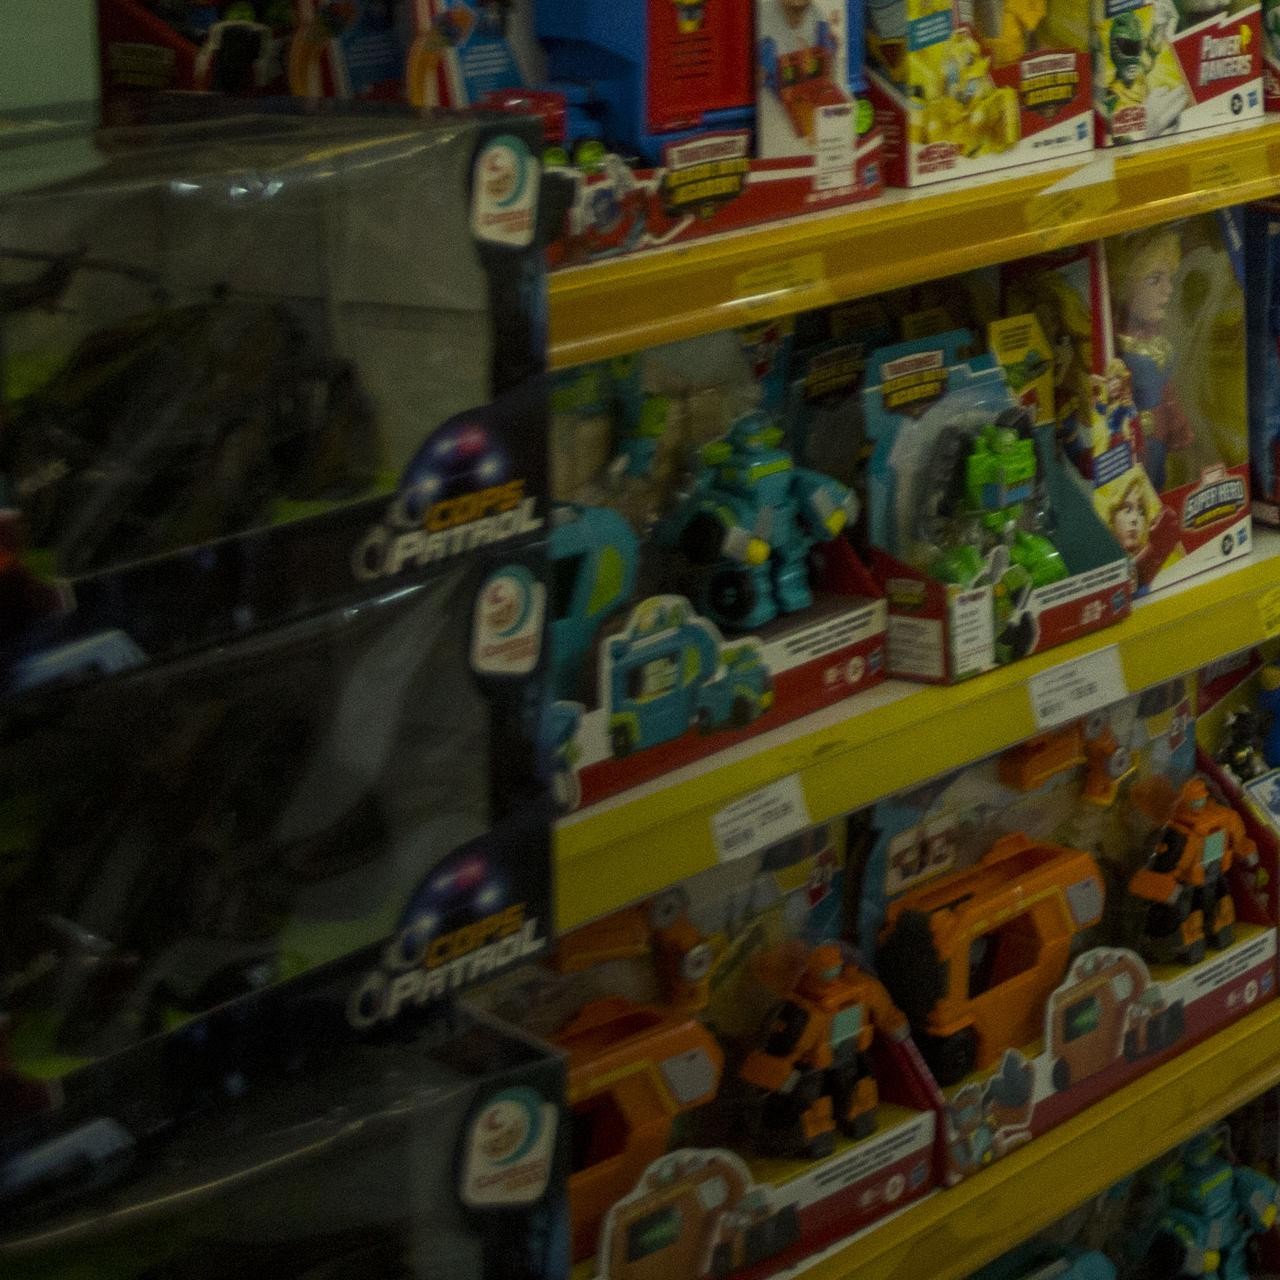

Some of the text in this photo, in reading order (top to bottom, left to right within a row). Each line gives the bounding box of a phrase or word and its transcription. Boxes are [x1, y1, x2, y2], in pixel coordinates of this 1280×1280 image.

[384, 497, 545, 576] PATROL
[424, 479, 526, 534] COPS
[386, 917, 547, 1018] PATROL
